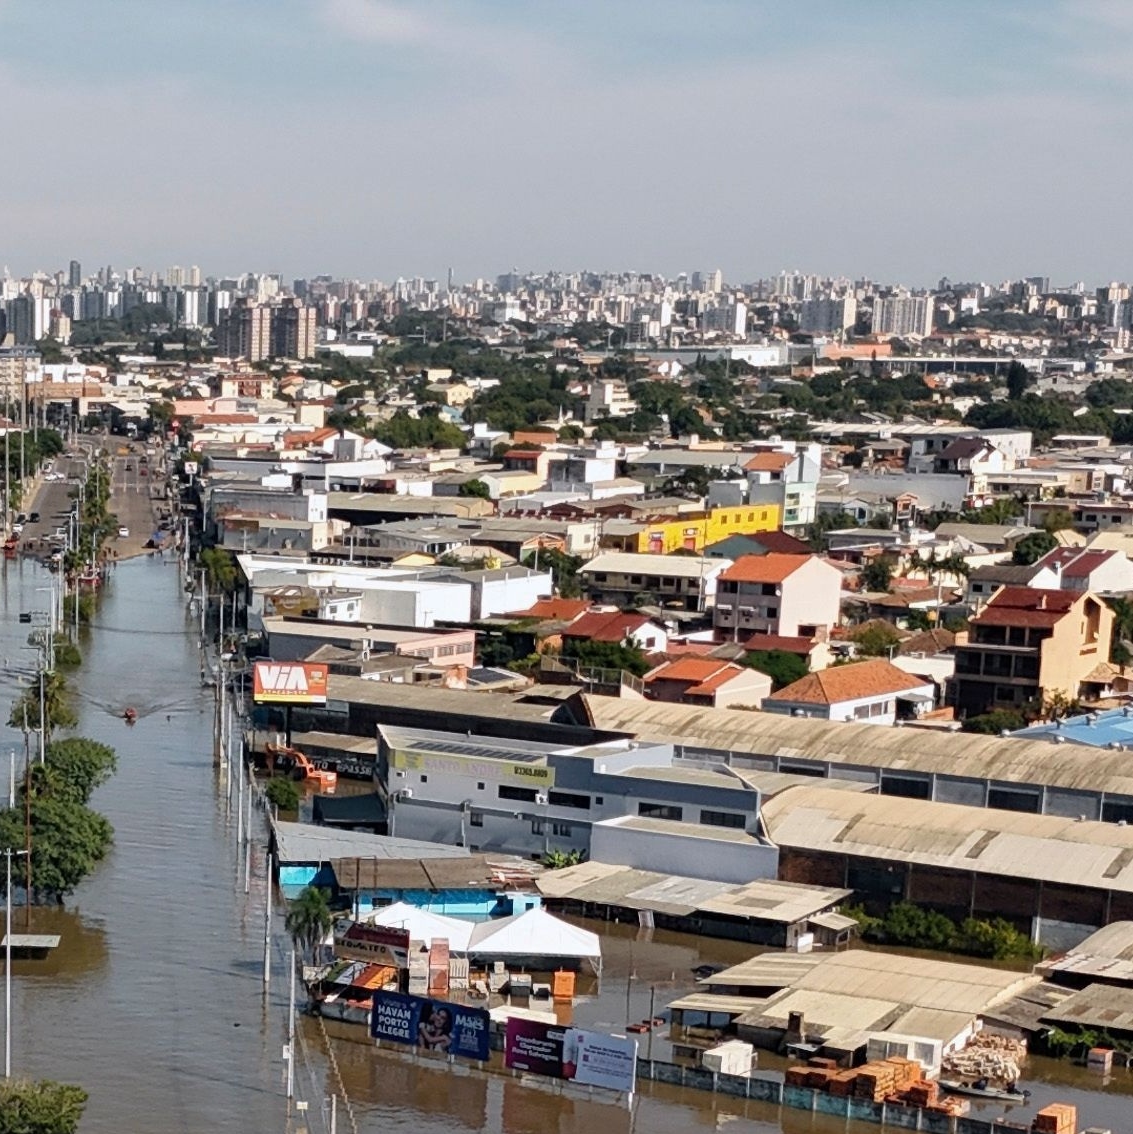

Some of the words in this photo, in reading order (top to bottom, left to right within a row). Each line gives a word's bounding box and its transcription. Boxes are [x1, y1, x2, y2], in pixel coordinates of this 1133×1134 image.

[377, 1004, 411, 1019] HAVAN
[378, 1015, 409, 1029] PORTO
[376, 1024, 410, 1039] ALEGRE
